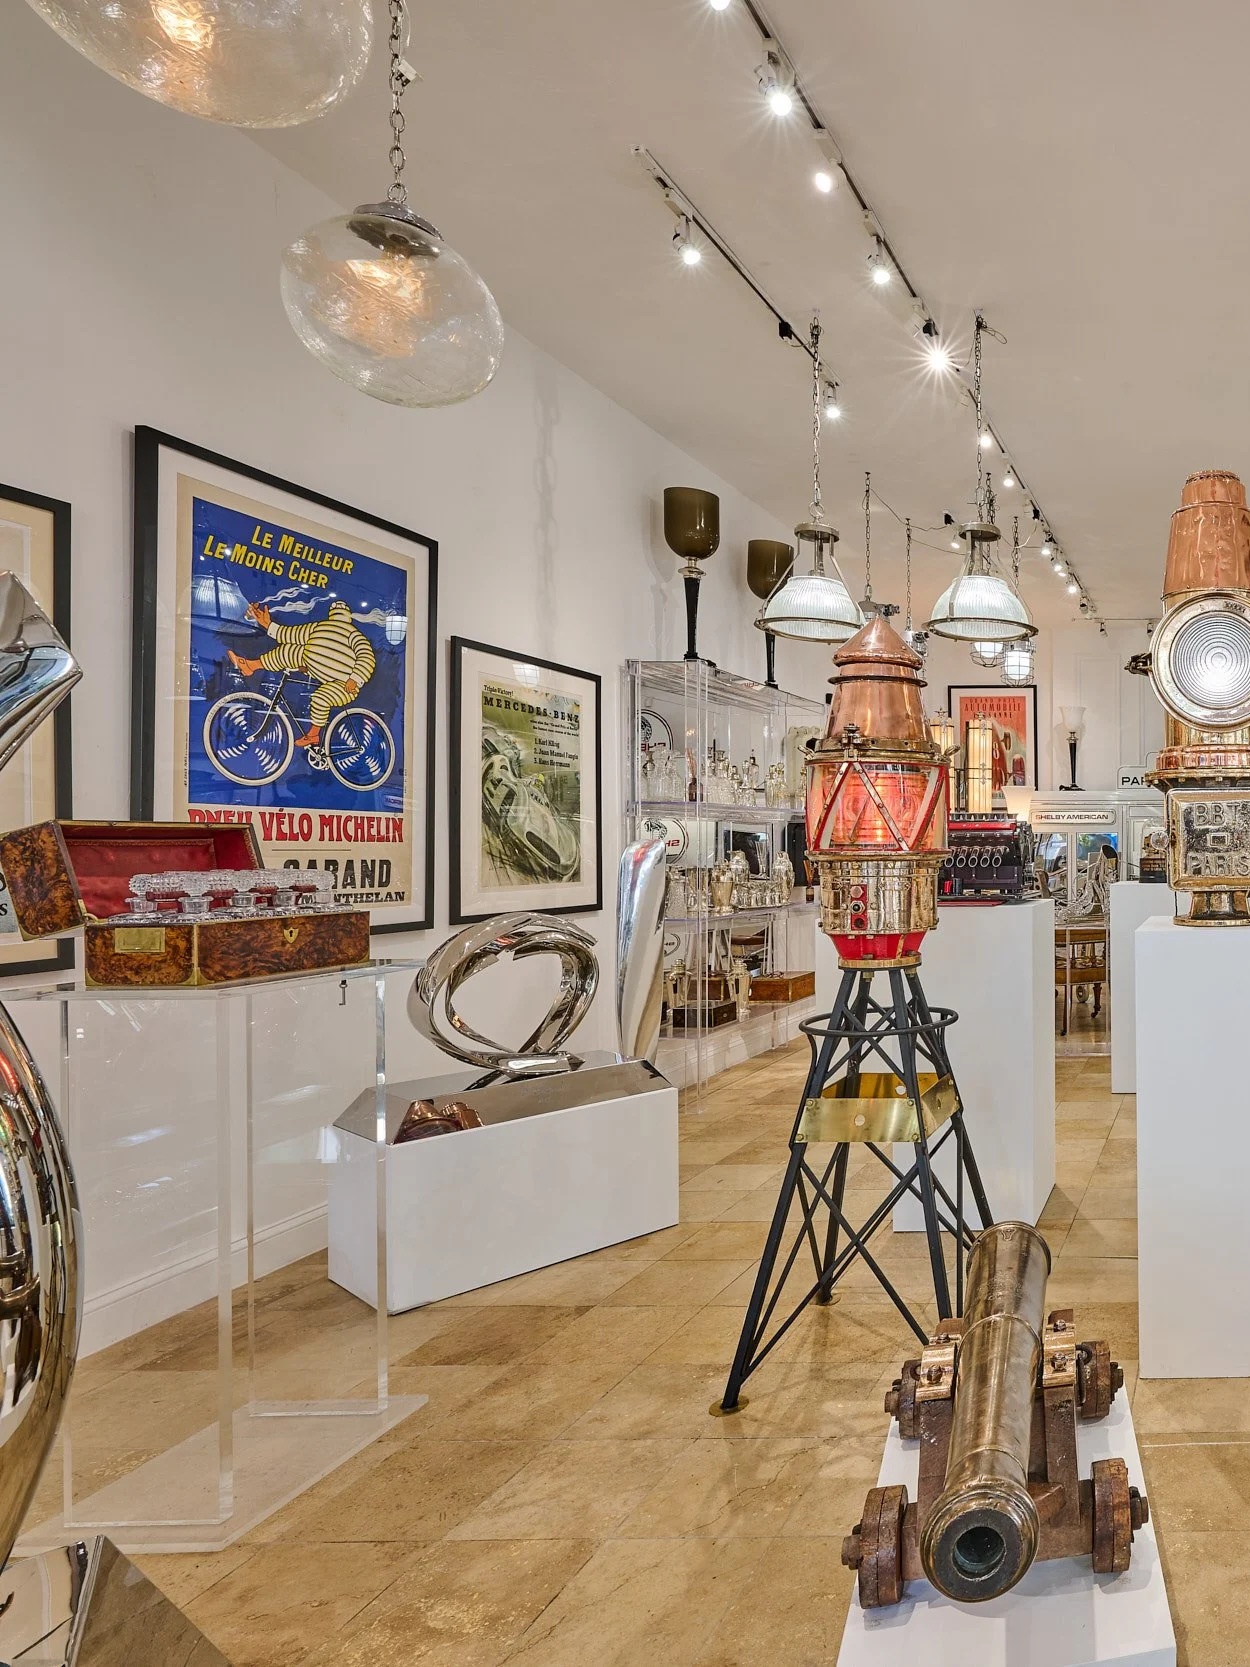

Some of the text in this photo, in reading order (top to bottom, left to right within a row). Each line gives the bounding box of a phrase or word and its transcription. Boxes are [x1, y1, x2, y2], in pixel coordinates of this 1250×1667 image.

[203, 534, 329, 589] LE MOINS CHER
[251, 525, 354, 575] LE MEILLEUR
[259, 808, 313, 842] VÉLO
[318, 814, 404, 843] MICHELIN
[1187, 853, 1250, 877] PARIS
